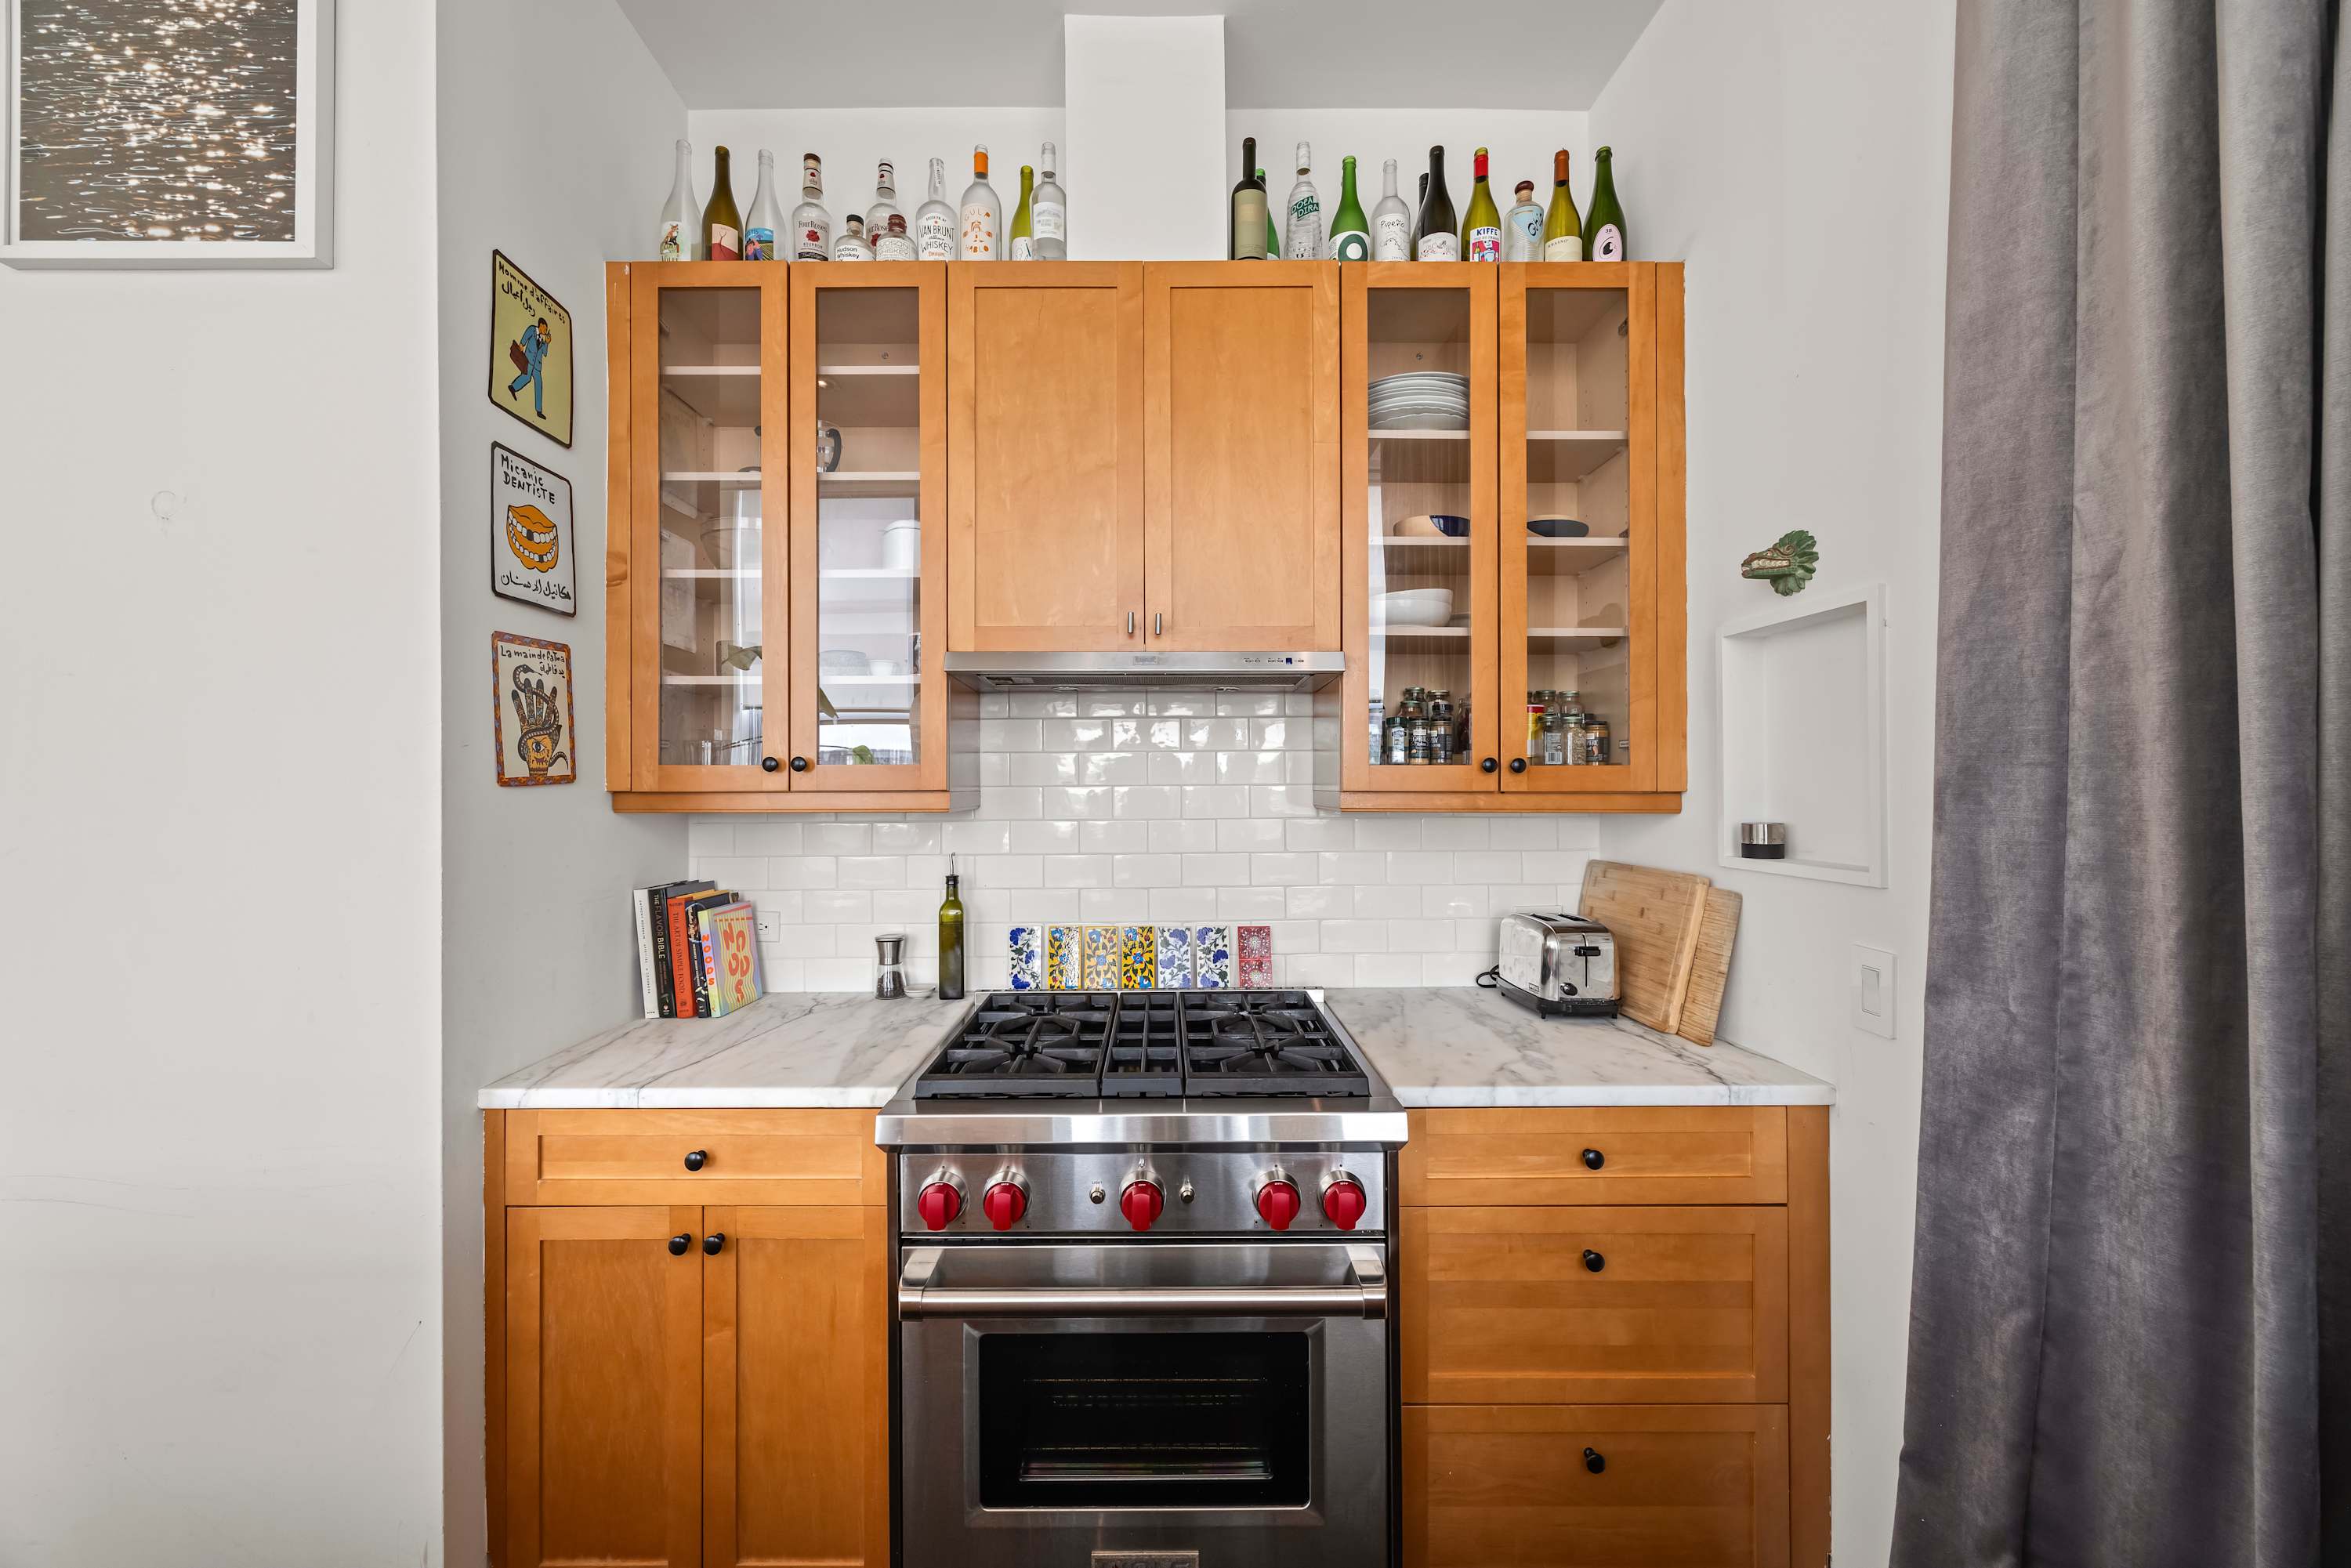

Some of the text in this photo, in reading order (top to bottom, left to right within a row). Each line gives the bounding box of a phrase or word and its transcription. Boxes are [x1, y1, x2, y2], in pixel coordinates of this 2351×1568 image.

[1298, 204, 1319, 218] DIRA
[799, 220, 828, 233] Four Roses
[1380, 219, 1404, 229] Pipeño
[1476, 227, 1498, 236] KIFFE
[918, 225, 955, 242] VAN BRUNT
[836, 251, 860, 259] Whiskey
[920, 241, 954, 255] WHISKEY
[498, 260, 566, 324] Homme d'affaires
[501, 454, 544, 487] Micanic
[500, 645, 512, 658] La
[514, 649, 536, 659] main
[537, 650, 546, 661] de
[654, 905, 664, 937] FLAVOR
[657, 937, 665, 959] BIBLE
[675, 948, 683, 972] SIMPLE
[701, 933, 715, 986] NOODS
